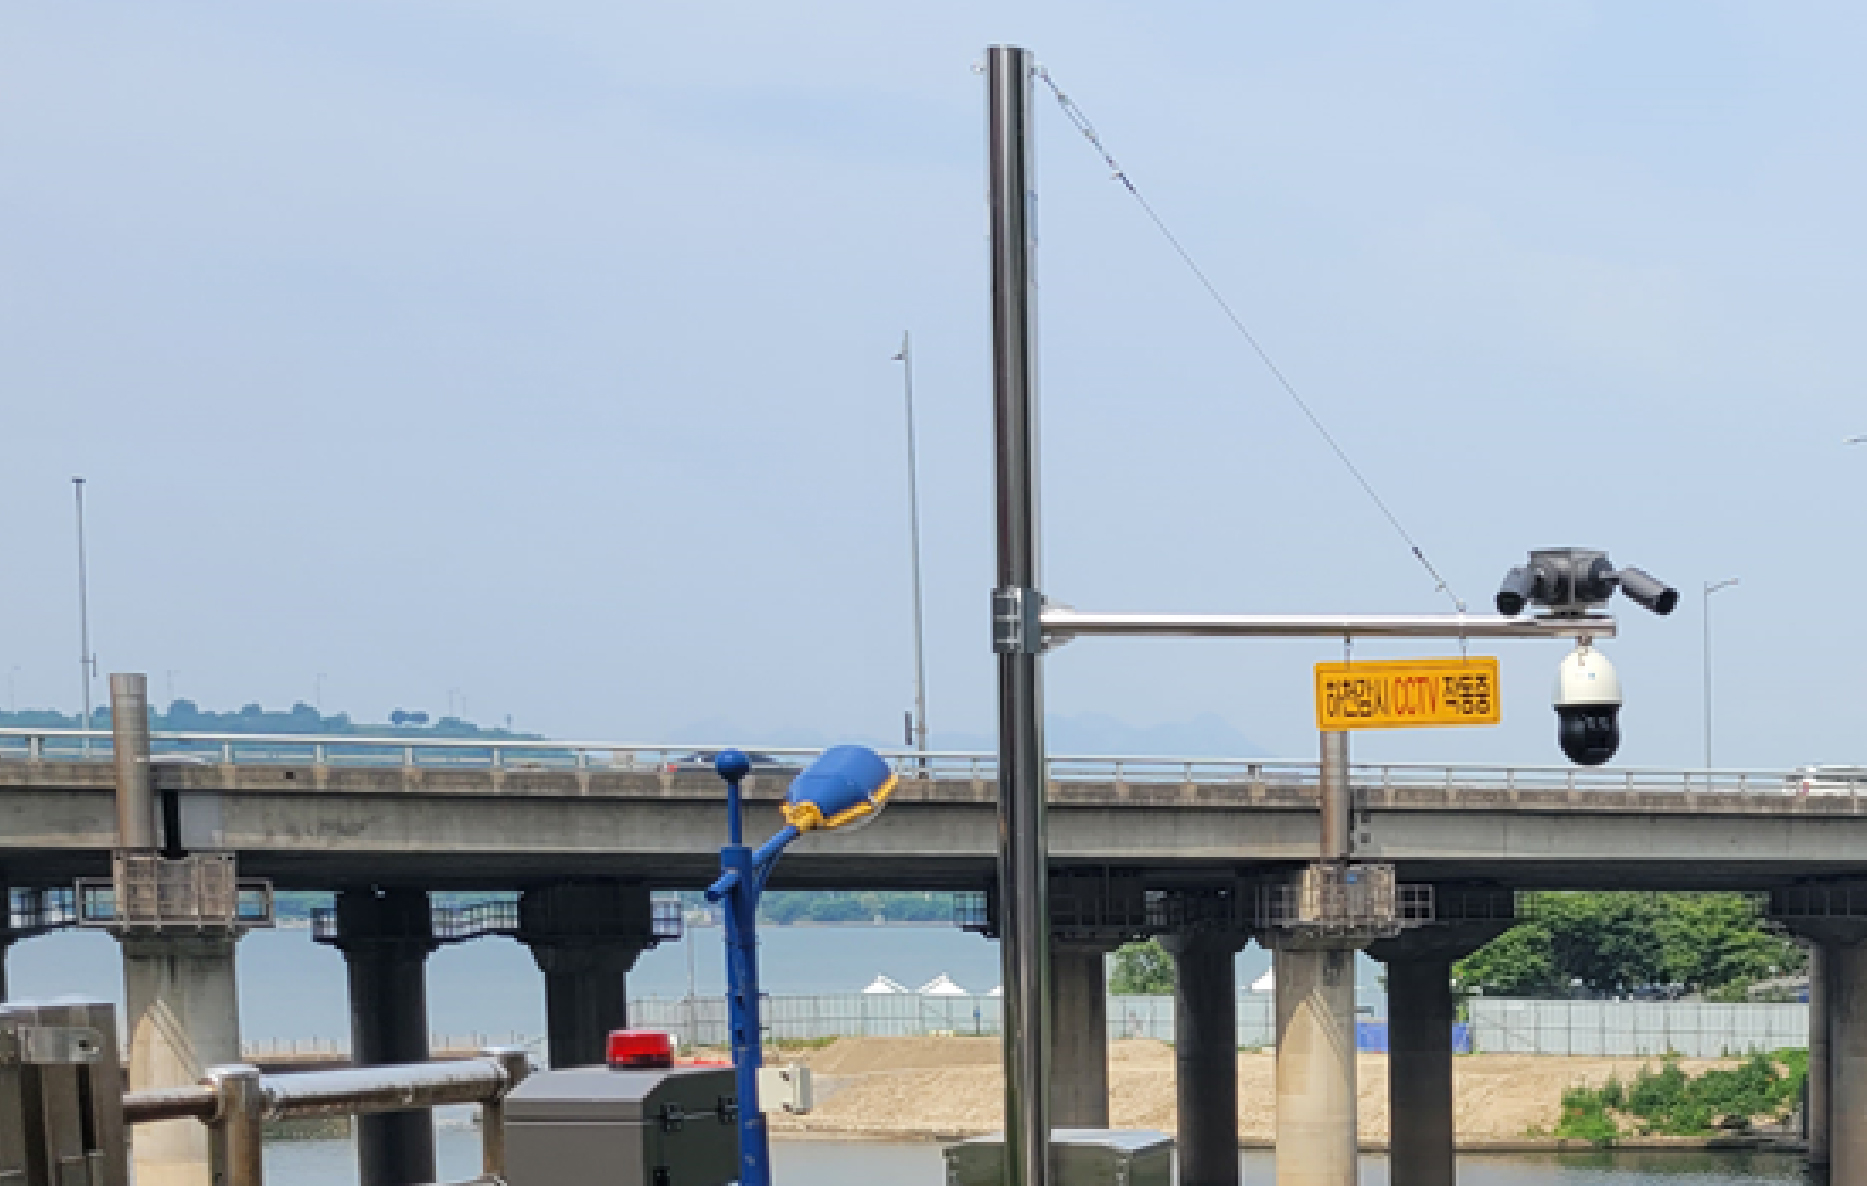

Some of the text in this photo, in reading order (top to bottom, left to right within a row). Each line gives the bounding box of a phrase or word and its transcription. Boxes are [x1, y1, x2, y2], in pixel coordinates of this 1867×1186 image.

[1325, 673, 1491, 719] 하천감시 CCTV 작동중
